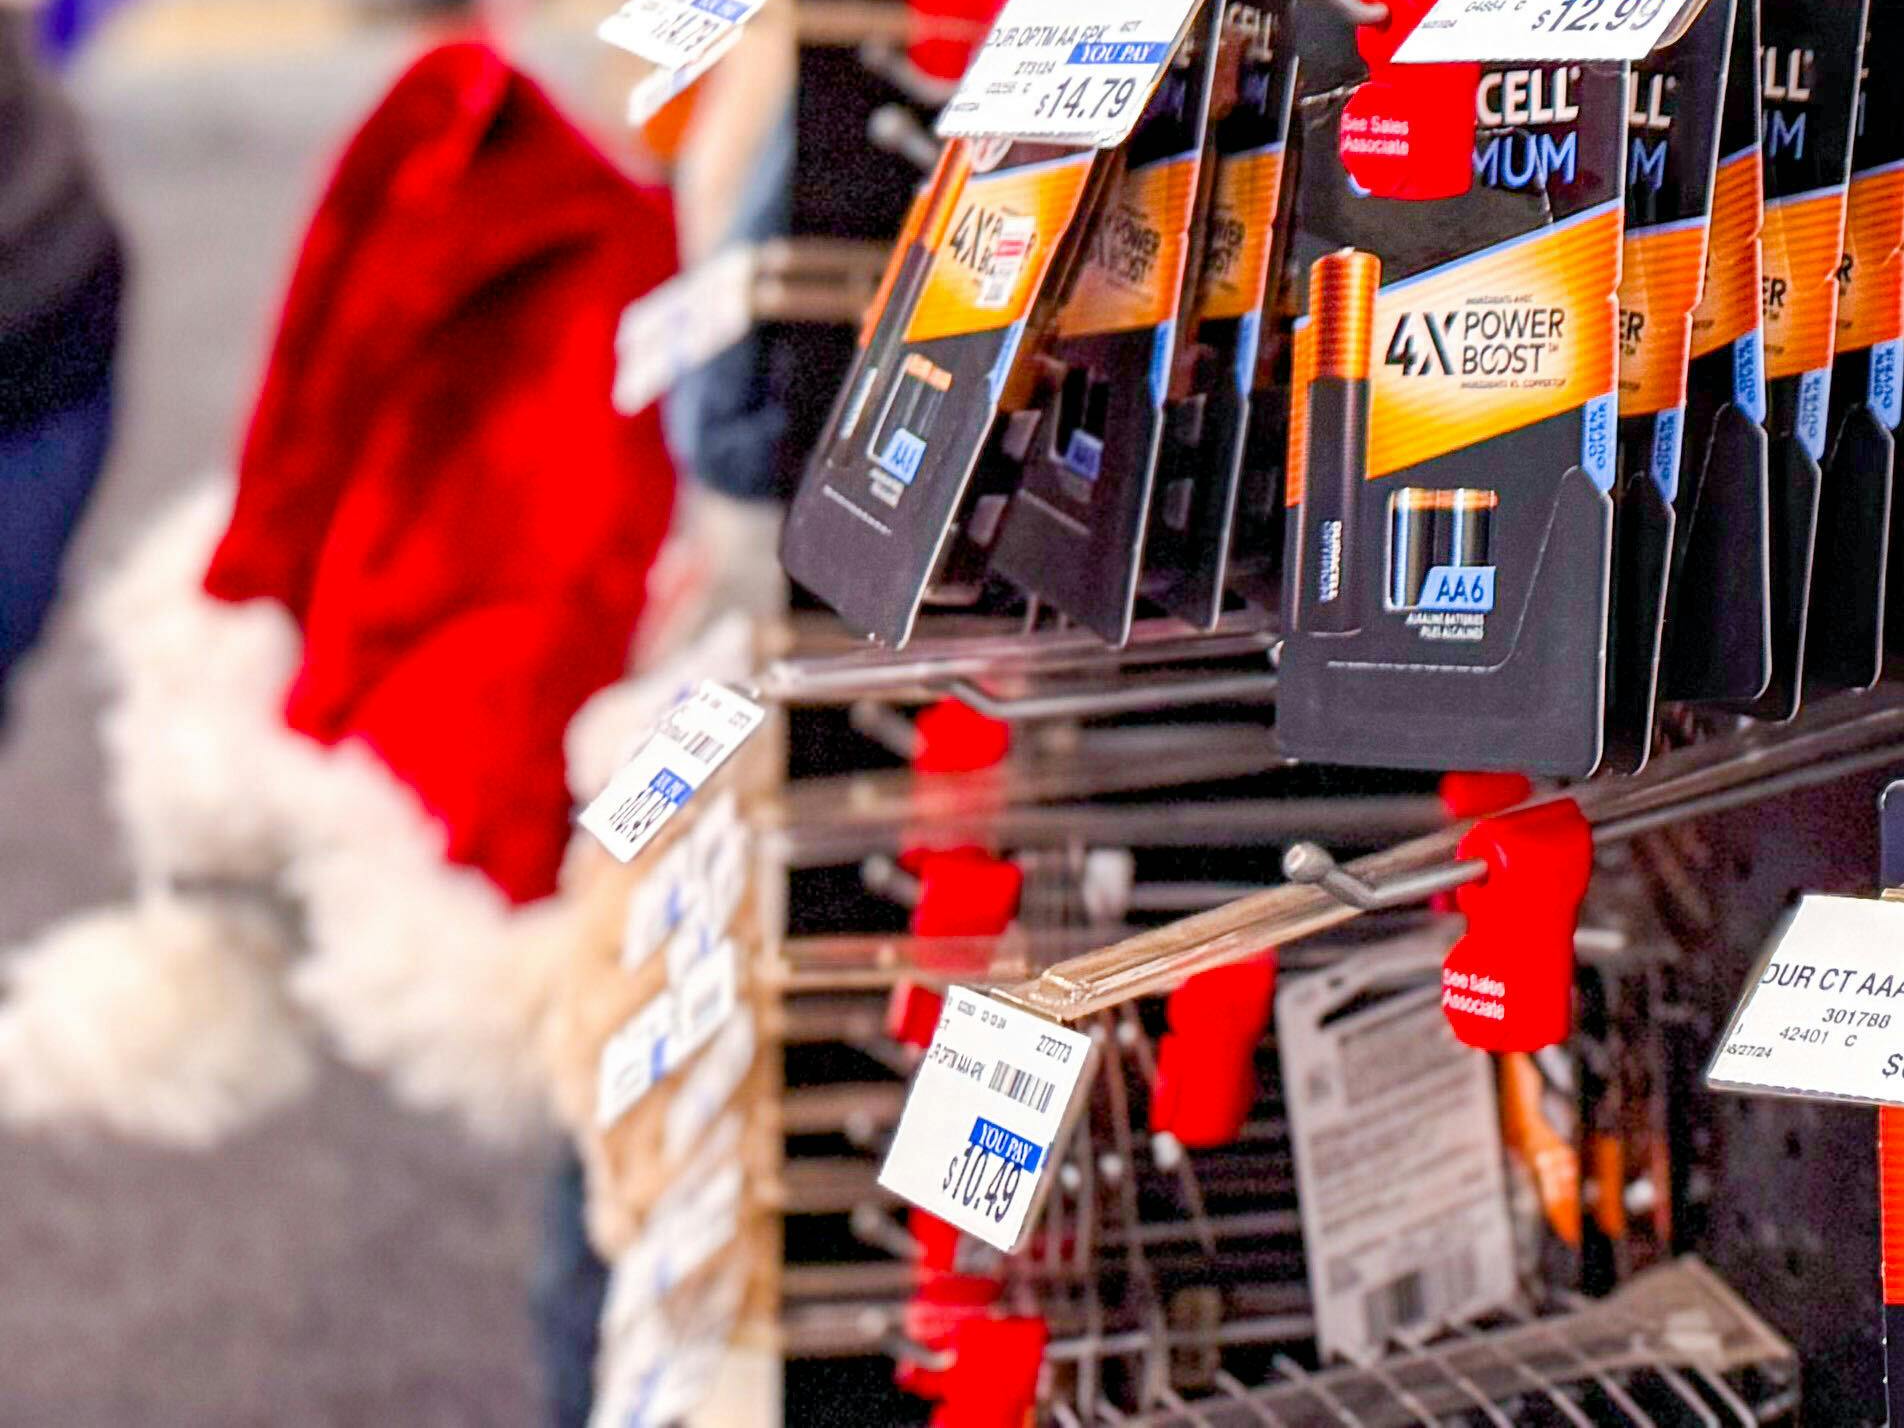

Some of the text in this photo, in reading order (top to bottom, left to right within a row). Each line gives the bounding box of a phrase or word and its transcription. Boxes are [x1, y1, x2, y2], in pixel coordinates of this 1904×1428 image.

[1037, 76, 1136, 120] $14.79
[1385, 308, 1565, 376] 4X POWER
[1462, 344, 1544, 375] BOOST
[1819, 970, 1853, 994] CT
[1779, 1028, 1829, 1045] 42401
[942, 1147, 1024, 1225] $10.49
